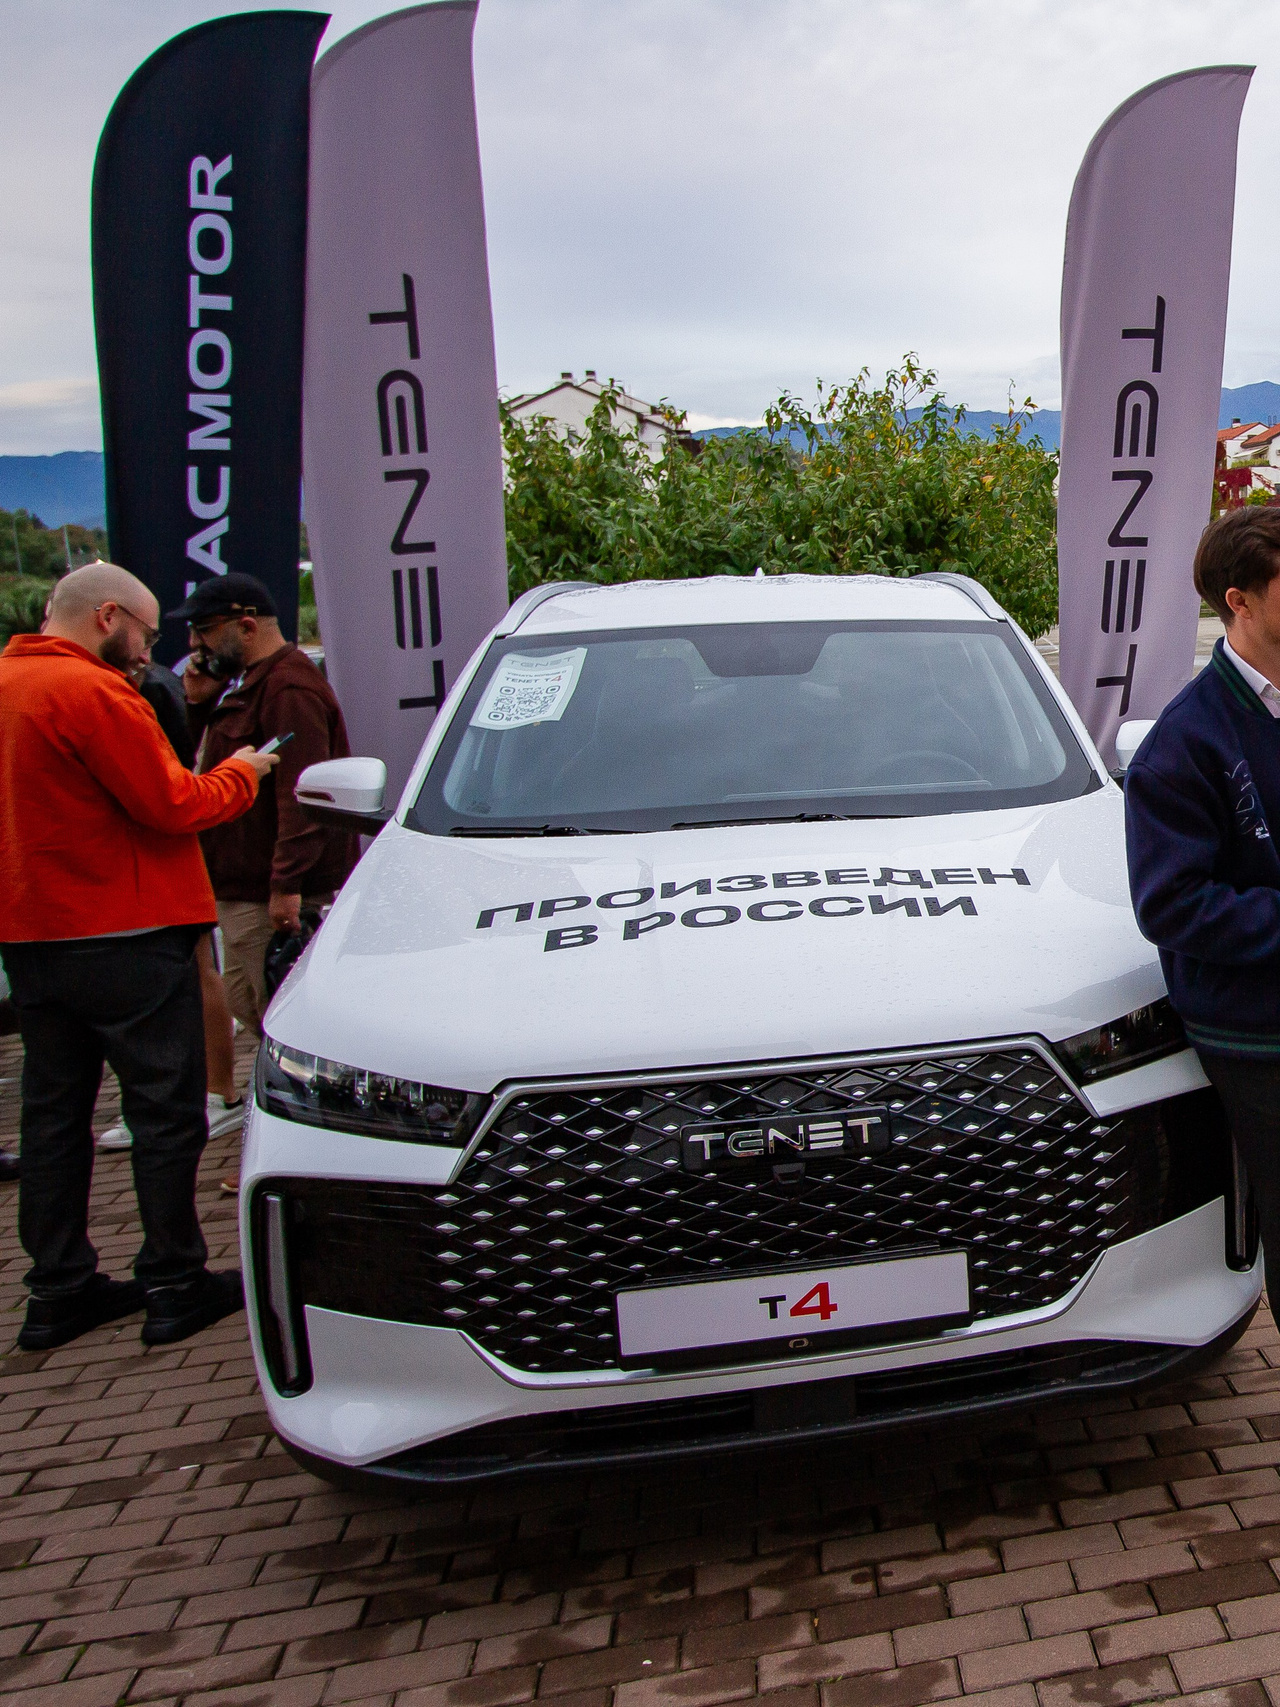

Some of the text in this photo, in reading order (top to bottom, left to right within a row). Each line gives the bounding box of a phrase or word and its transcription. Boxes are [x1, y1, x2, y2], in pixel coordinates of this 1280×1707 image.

[184, 153, 233, 600] AC MOTOR
[368, 272, 447, 716] TENET
[1095, 294, 1166, 718] TENET
[505, 676, 540, 684] TENET
[475, 867, 1032, 929] ПРОИЗВЕДЕН
[543, 894, 979, 953] В РОССИИ
[687, 1115, 883, 1161] TENET
[758, 1281, 839, 1321] T4
